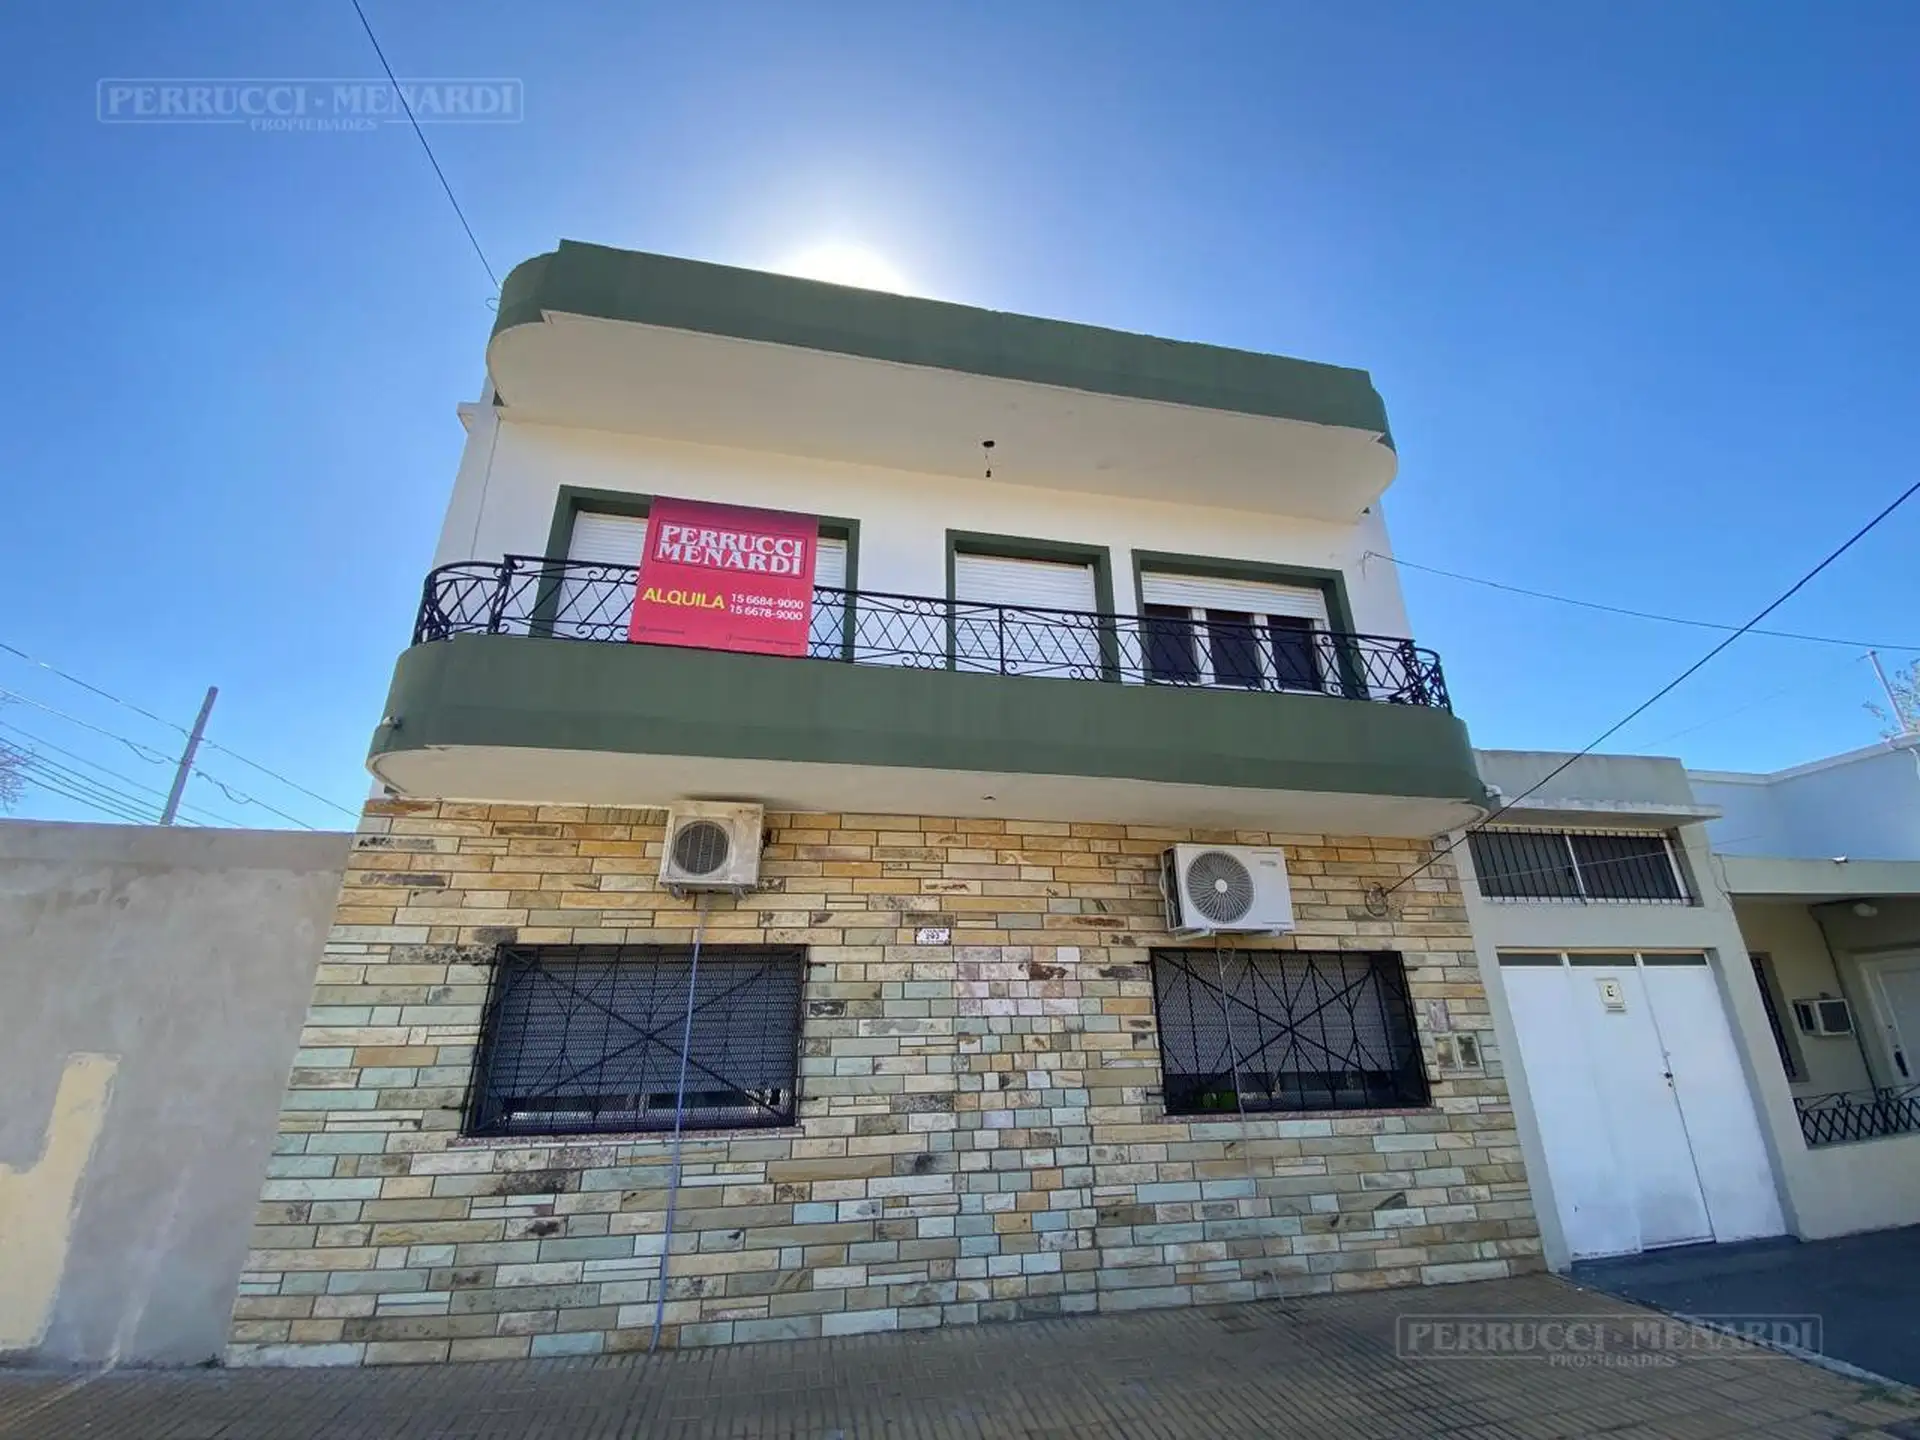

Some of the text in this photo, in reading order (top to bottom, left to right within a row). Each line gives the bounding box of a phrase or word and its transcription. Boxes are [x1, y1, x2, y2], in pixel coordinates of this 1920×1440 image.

[660, 524, 804, 558] PERRUCCI
[658, 543, 802, 575] MENARDI
[642, 587, 725, 609] ALQUILA
[731, 593, 804, 610] 15 6684-9000
[729, 604, 803, 621] 15 6678-9000
